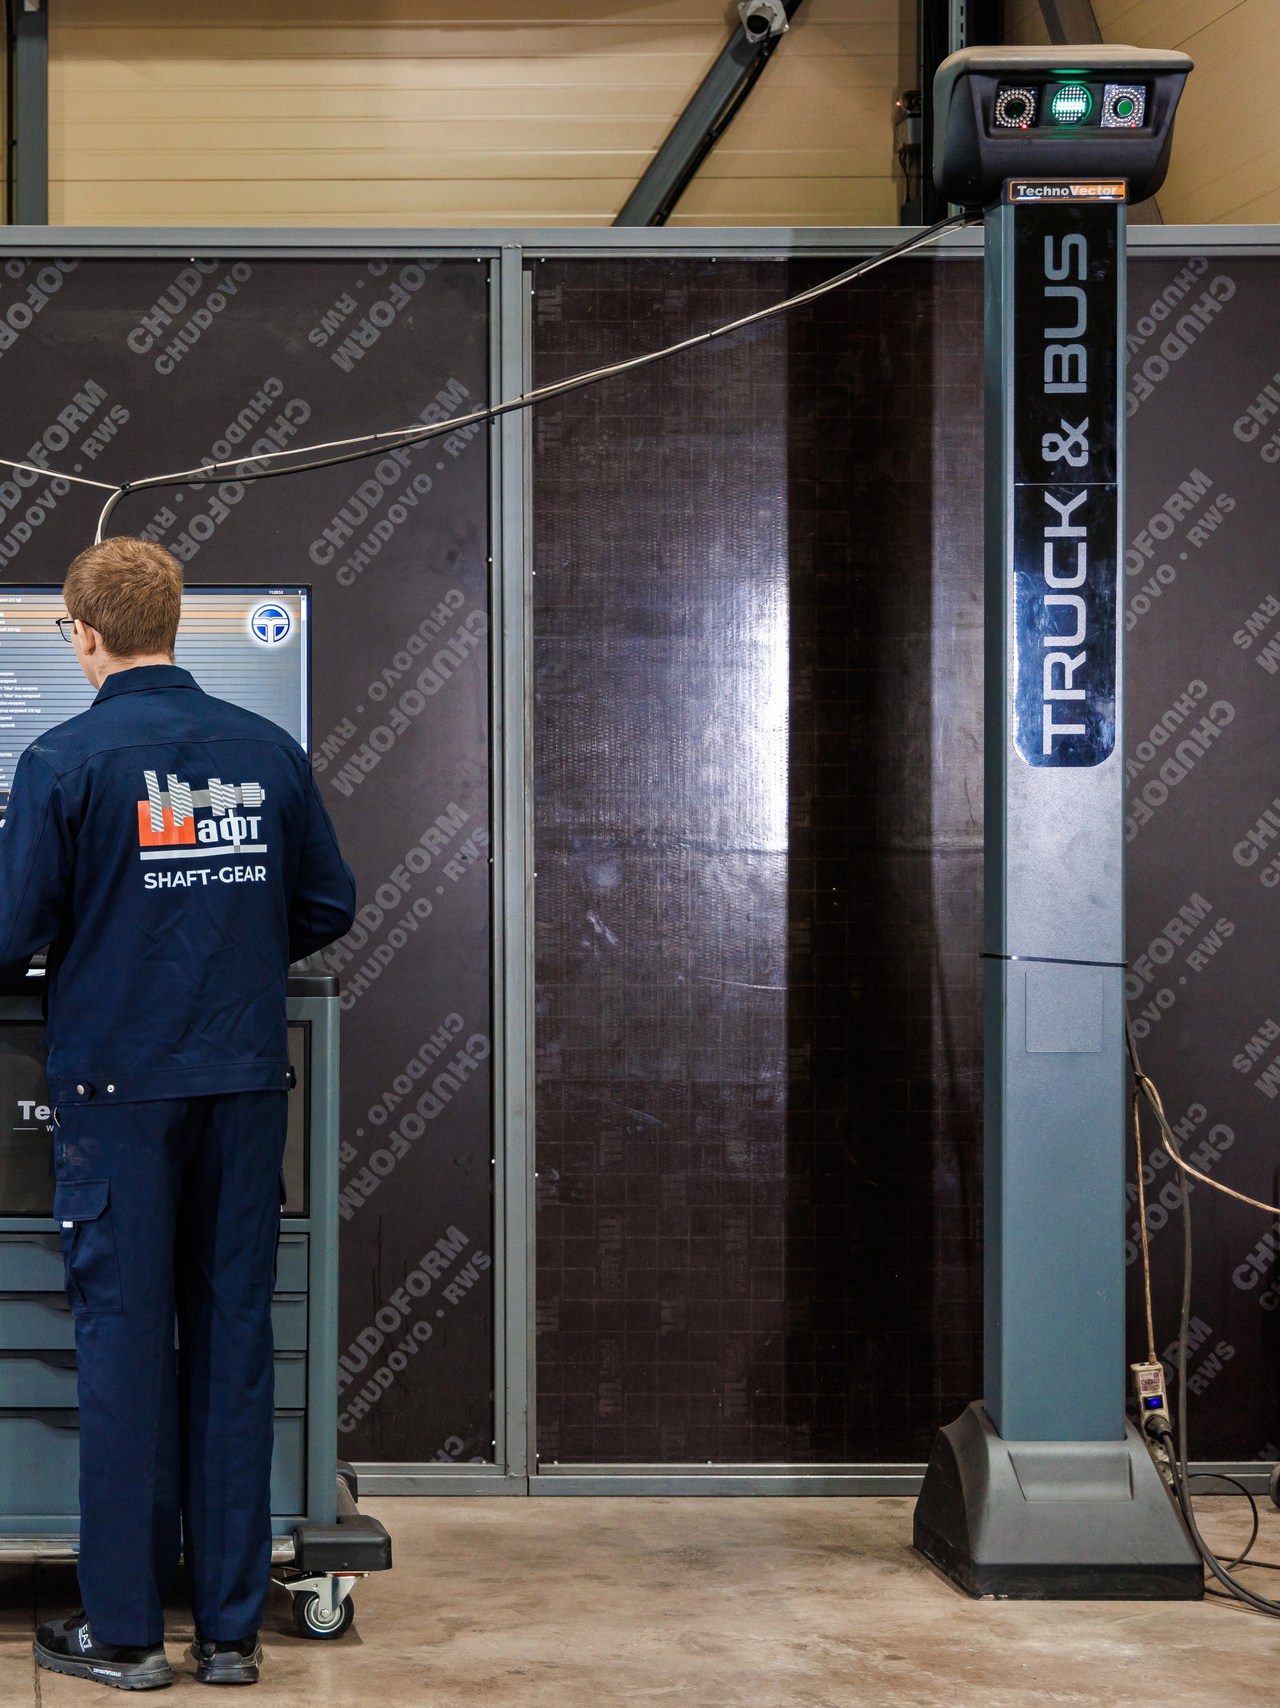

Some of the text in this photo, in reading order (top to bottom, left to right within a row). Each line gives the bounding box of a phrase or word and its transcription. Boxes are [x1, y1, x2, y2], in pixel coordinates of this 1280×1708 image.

[1017, 185, 1118, 196] TechnoVector
[155, 263, 252, 374] CHUDOVO
[308, 293, 357, 347] RWS
[81, 405, 130, 459] RWS
[168, 399, 311, 569] CHUDOFOR
[139, 506, 176, 541] RW
[336, 474, 433, 585] CHUDOVO
[1042, 233, 1089, 756] TRUCK & BUS
[1125, 468, 1212, 575] OFORM
[1186, 494, 1235, 548] RWS
[1233, 595, 1280, 649] RWS
[313, 589, 464, 771] CHUDOVO RWS
[331, 610, 492, 797] CHUDOFORM
[1125, 680, 1207, 790] CHUDOV
[143, 865, 267, 889] SHAFT-GEAR
[326, 802, 469, 975] HUDOFORM
[443, 828, 492, 882] RWS
[1125, 892, 1212, 999] OFORM
[1186, 918, 1235, 972] RWS
[367, 1013, 464, 1124] CHUDOVO
[1232, 1019, 1280, 1073] RWS
[340, 1225, 469, 1395] UDOFORM
[340, 1251, 492, 1433] CHUDOVO RWS
[80, 1623, 93, 1649] EA7
